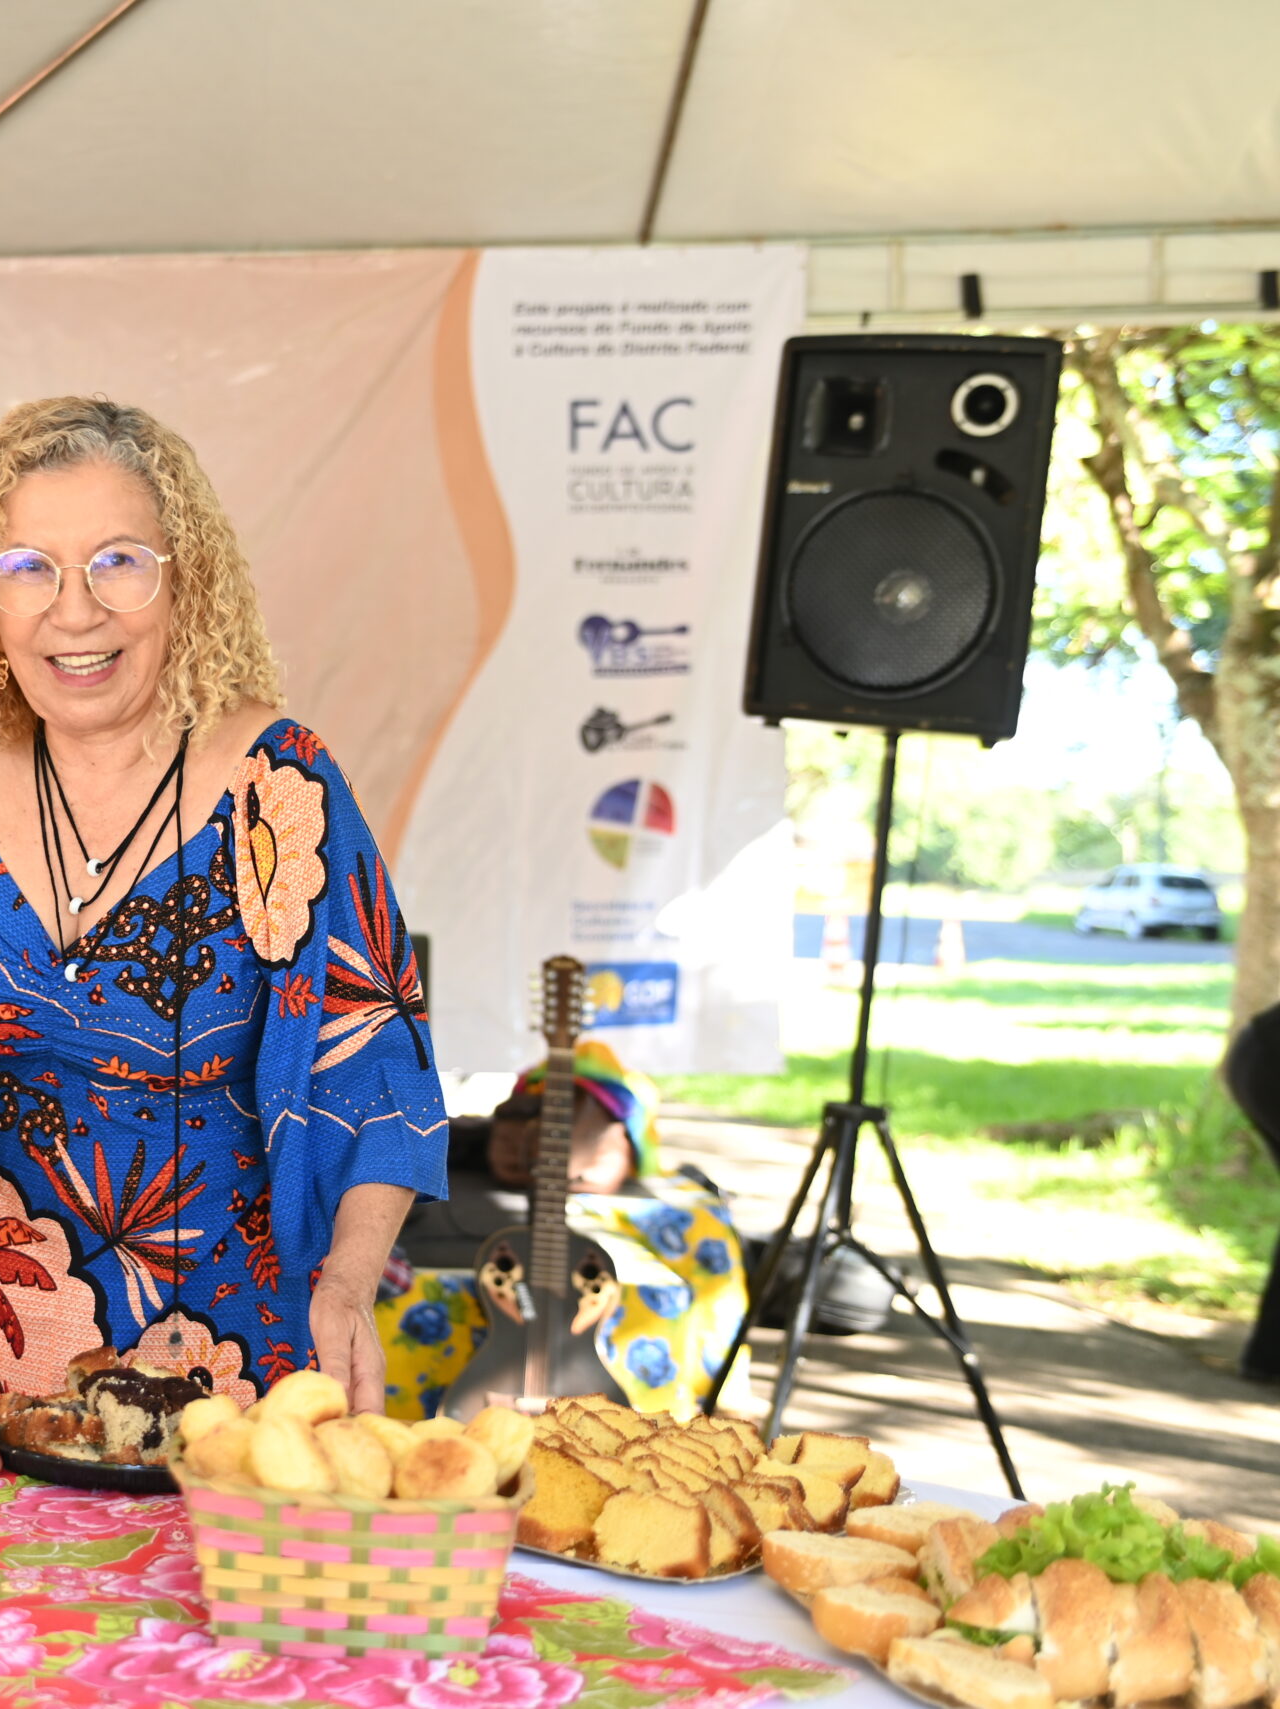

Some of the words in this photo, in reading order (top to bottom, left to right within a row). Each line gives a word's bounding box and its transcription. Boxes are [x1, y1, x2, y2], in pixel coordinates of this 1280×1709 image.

[514, 302, 550, 315] Este
[556, 304, 614, 318] projeto
[635, 300, 708, 314] realizado
[715, 302, 750, 313] com
[516, 324, 586, 335] recursos
[620, 320, 670, 334] Fundo
[704, 319, 750, 335] Apoio
[531, 342, 589, 356] Cultura
[622, 341, 680, 355] Distrito
[687, 339, 750, 354] Federal
[568, 397, 696, 453] FAC
[568, 479, 695, 502] CULTURA
